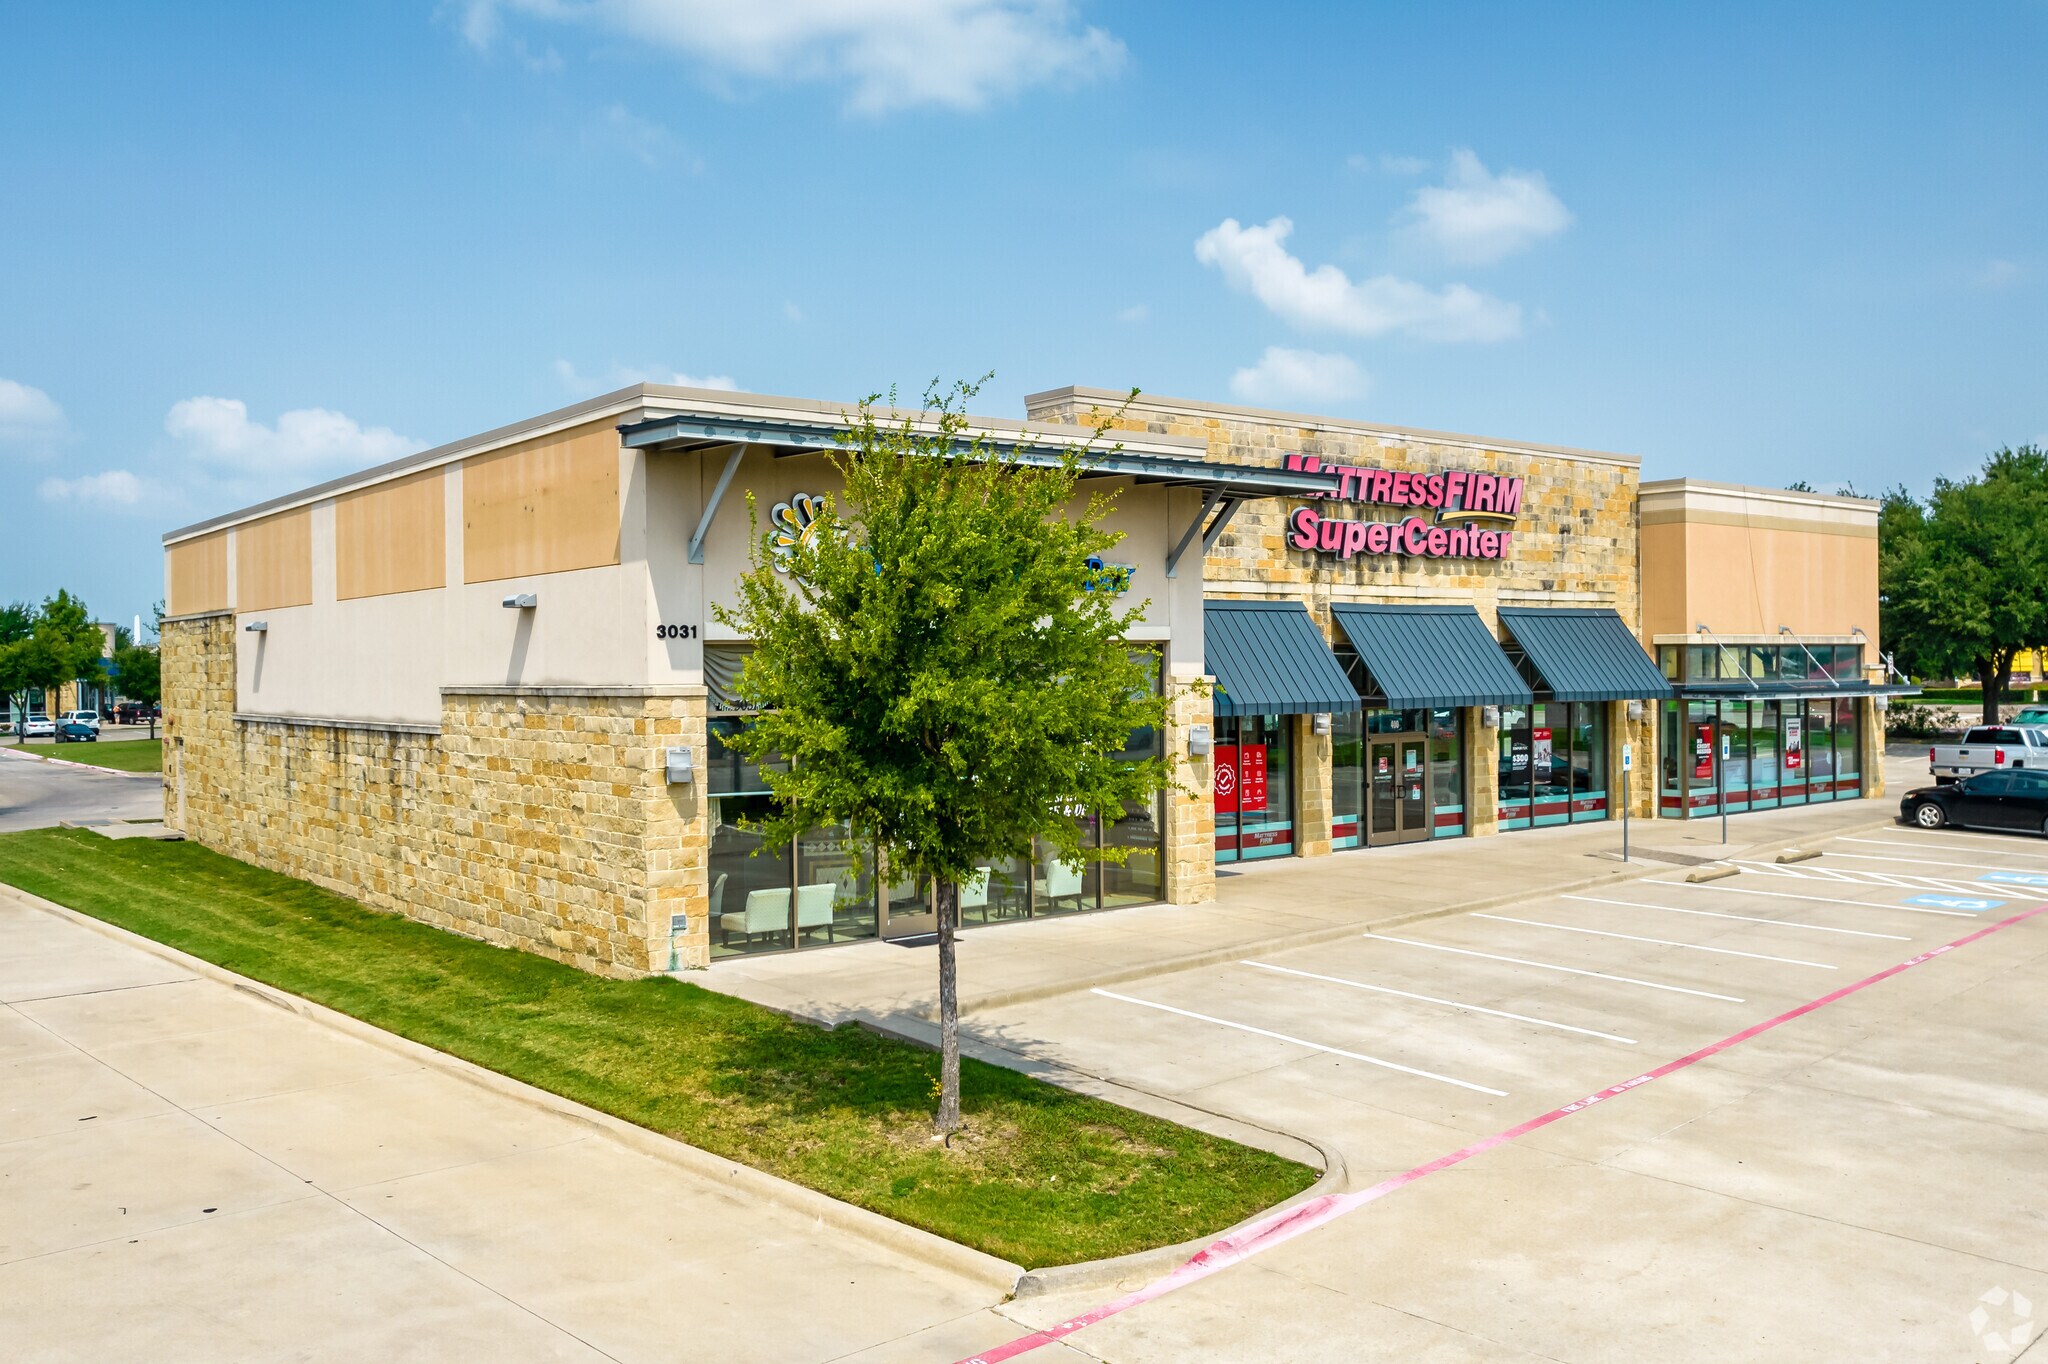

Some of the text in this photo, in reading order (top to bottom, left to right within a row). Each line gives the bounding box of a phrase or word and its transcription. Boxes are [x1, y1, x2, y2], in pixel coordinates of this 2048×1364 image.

[1443, 470, 1524, 514] FIRM
[1288, 508, 1513, 560] SuperCenter
[656, 624, 697, 639] 3031
